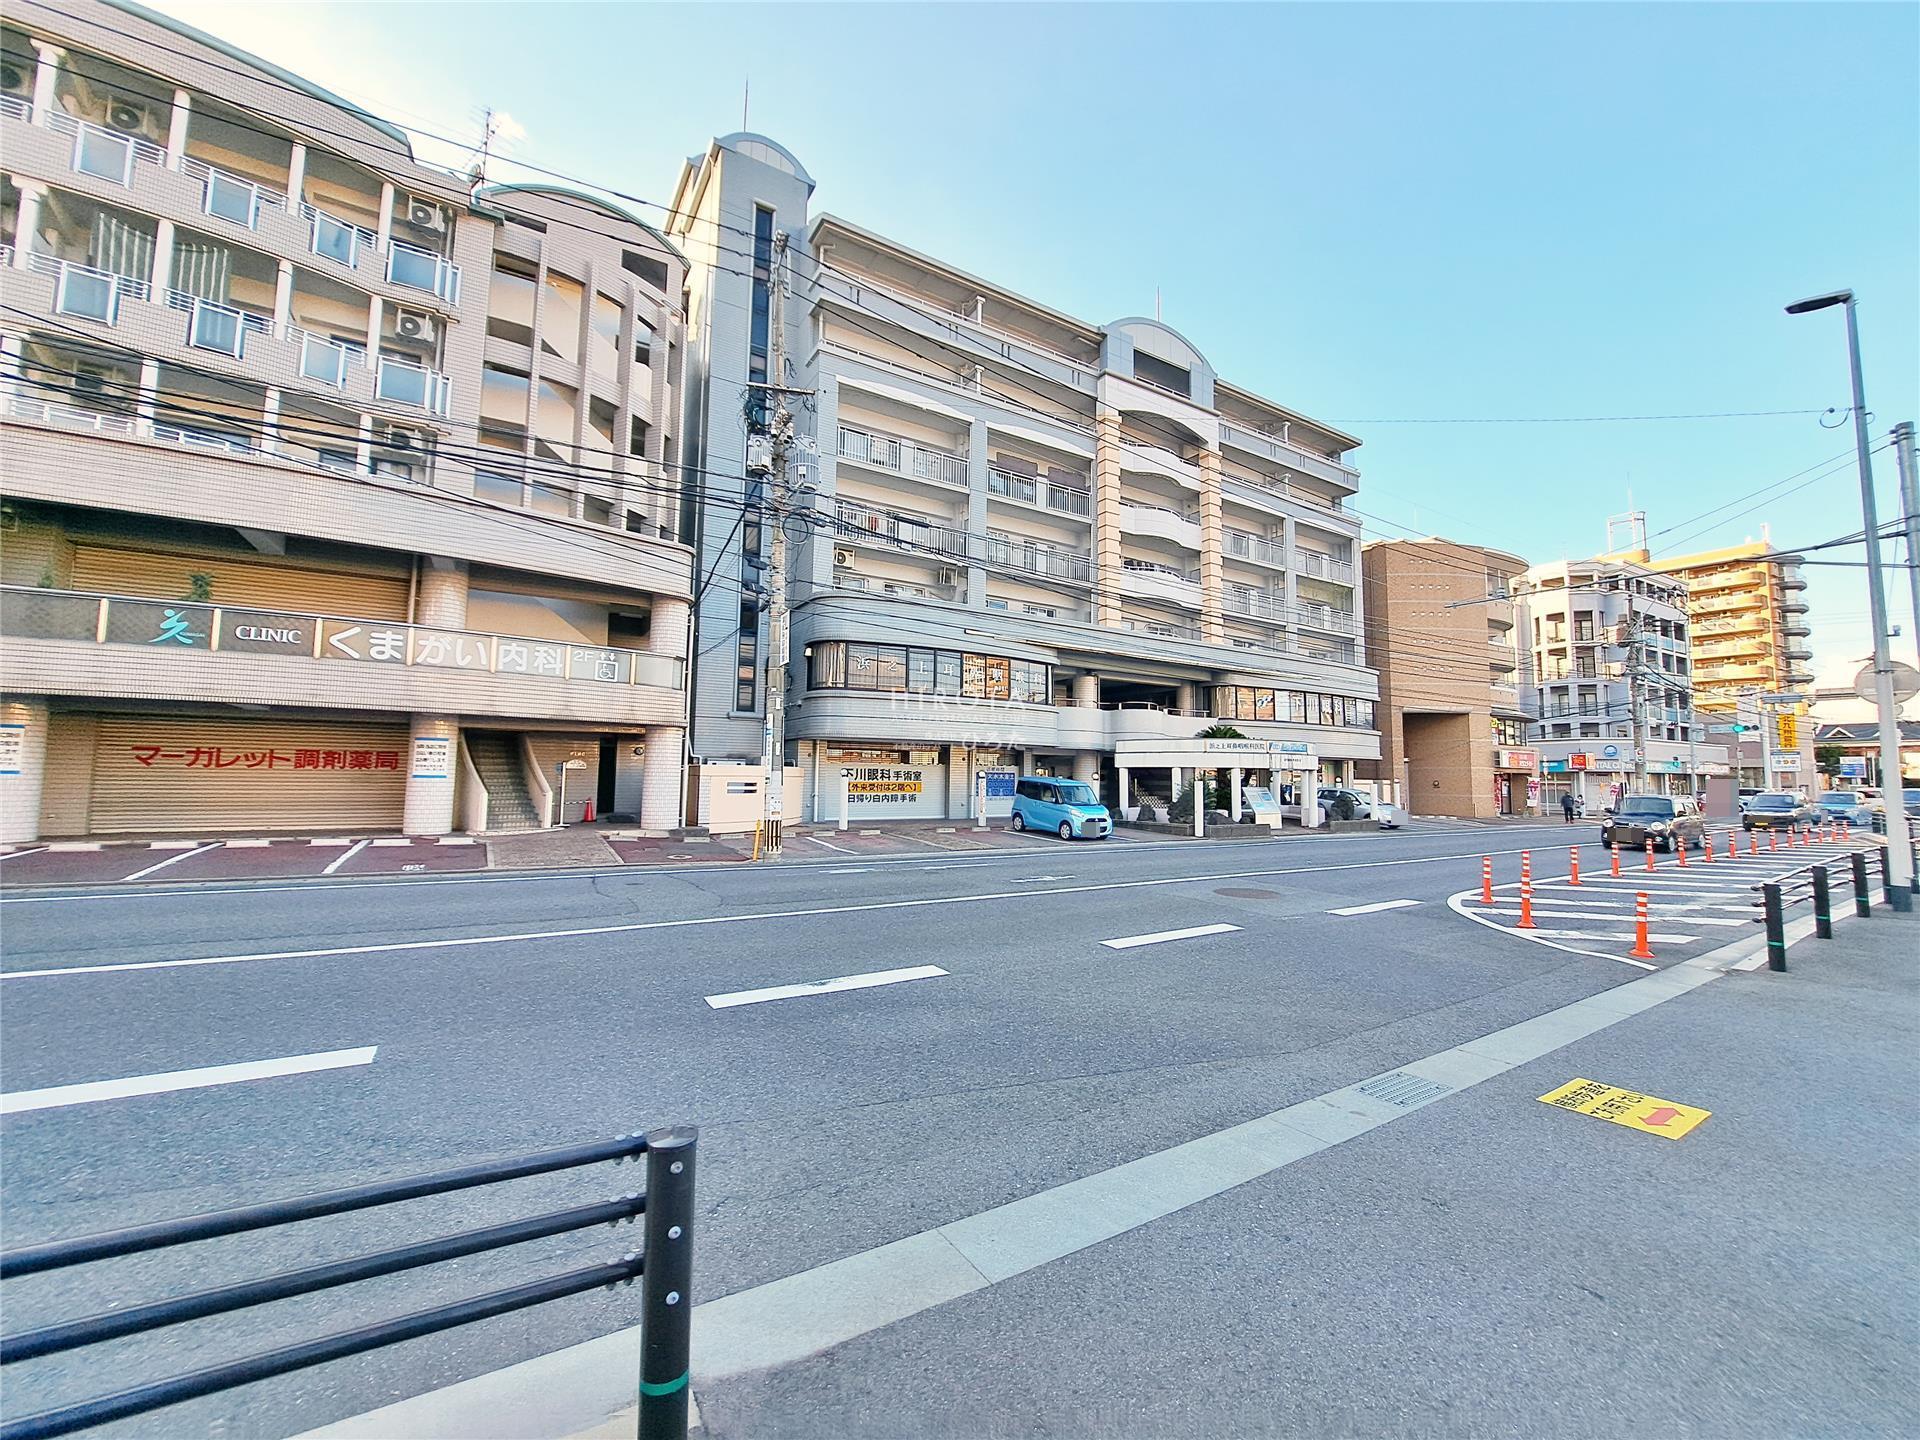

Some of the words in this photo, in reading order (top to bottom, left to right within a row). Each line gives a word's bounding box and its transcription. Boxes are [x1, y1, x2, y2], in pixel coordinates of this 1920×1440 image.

[235, 625, 302, 643] CLINIC
[328, 626, 563, 675] くまがい内科
[574, 650, 593, 663] 2F
[131, 746, 400, 770] マーガレット調剤薬局
